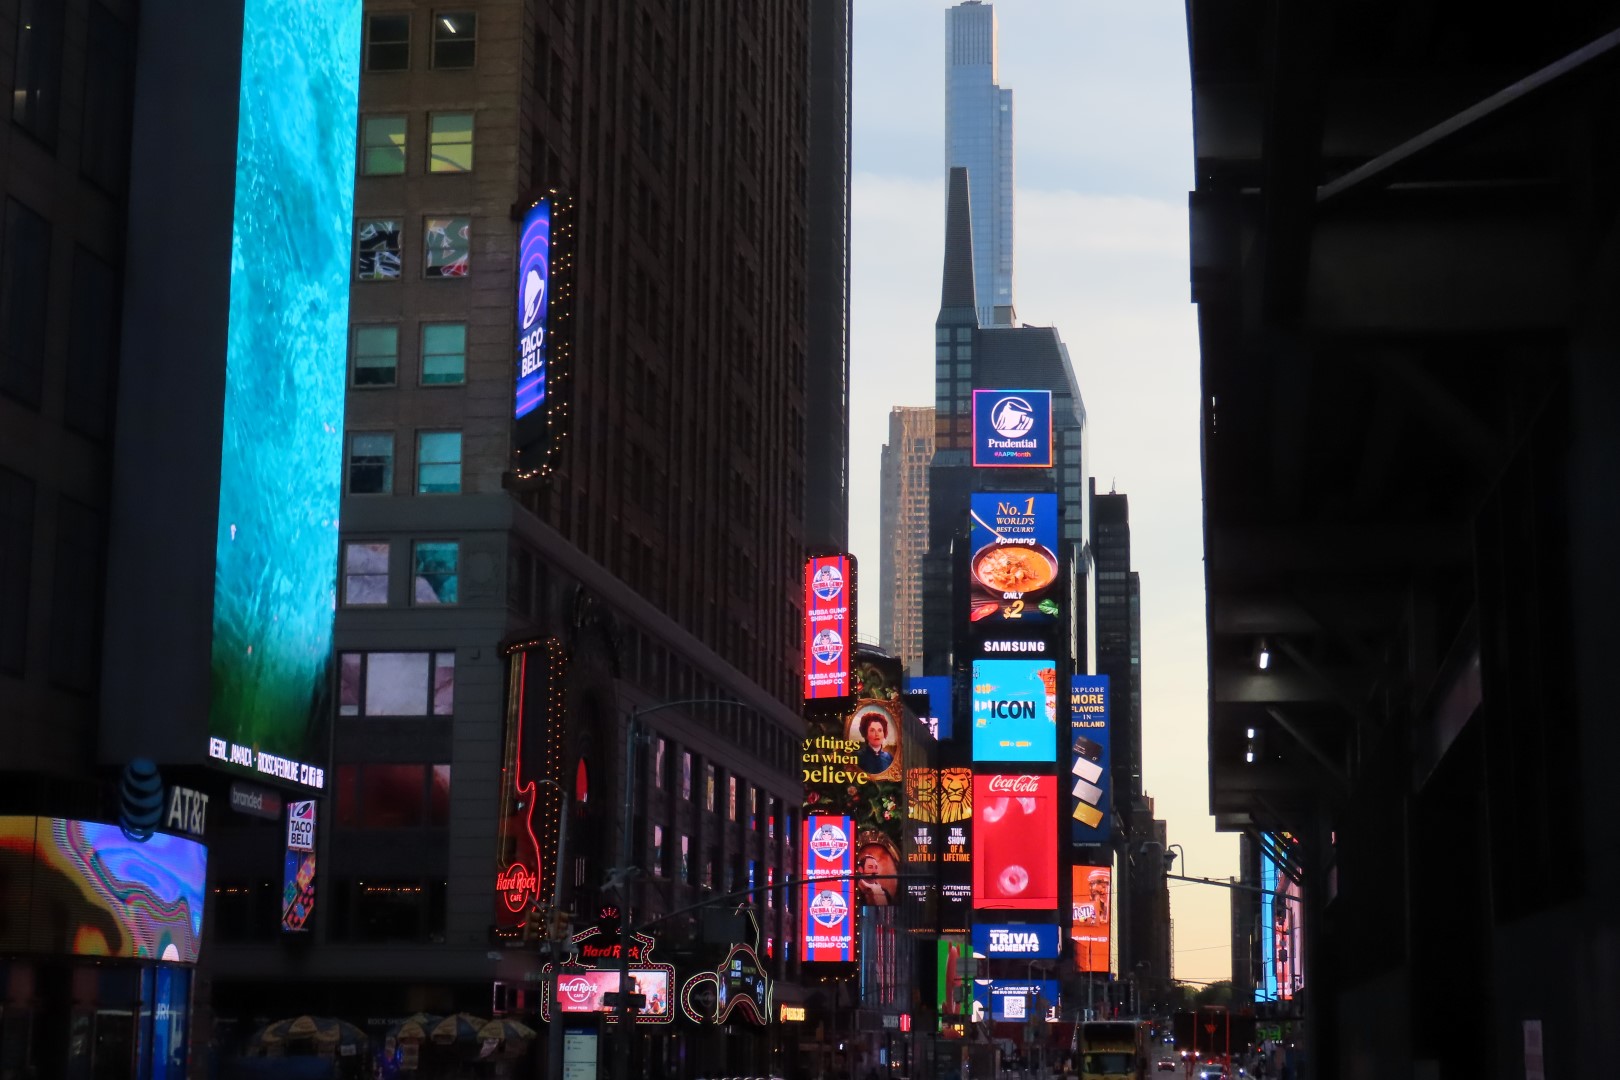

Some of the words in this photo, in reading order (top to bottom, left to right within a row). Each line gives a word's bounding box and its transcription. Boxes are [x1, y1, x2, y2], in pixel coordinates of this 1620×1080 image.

[521, 327, 543, 358] TACO
[521, 349, 543, 378] BELL
[988, 438, 1037, 449] Prudential
[996, 502, 1021, 516] No.
[1023, 497, 1036, 516] 1
[996, 517, 1035, 525] WORLD'S
[996, 536, 1036, 546] #panang
[1003, 592, 1024, 600] ONLY
[808, 608, 828, 616] BUBBA
[829, 607, 847, 615] GUMP
[1003, 600, 1024, 619] $2
[810, 614, 833, 622] SHRIMP
[984, 641, 1045, 652] SAMSUNG
[808, 672, 828, 680] BUBBA
[829, 671, 847, 679] GUMP
[810, 679, 833, 687] SHRIMP
[1071, 694, 1104, 704] MORE
[991, 700, 1036, 719] ICON
[815, 736, 860, 753] things
[822, 751, 858, 765] when
[989, 774, 1040, 792] Coca-Cola
[167, 785, 209, 836] AT&T
[290, 820, 312, 833] TACO
[950, 828, 962, 836] THE
[290, 833, 311, 846] BELL
[947, 836, 966, 844] SHOW
[950, 845, 957, 853] OF
[959, 845, 963, 853] A
[943, 853, 970, 862] LIFETIME
[496, 872, 517, 890] Hard
[516, 871, 536, 893] Rock
[510, 894, 522, 902] CAFE
[990, 933, 1039, 944] TRIVIA
[583, 945, 612, 957] Hard
[612, 943, 639, 960] Rck
[990, 943, 1039, 952] MOMENTS
[559, 982, 578, 992] Hard
[579, 982, 598, 993] Rock
